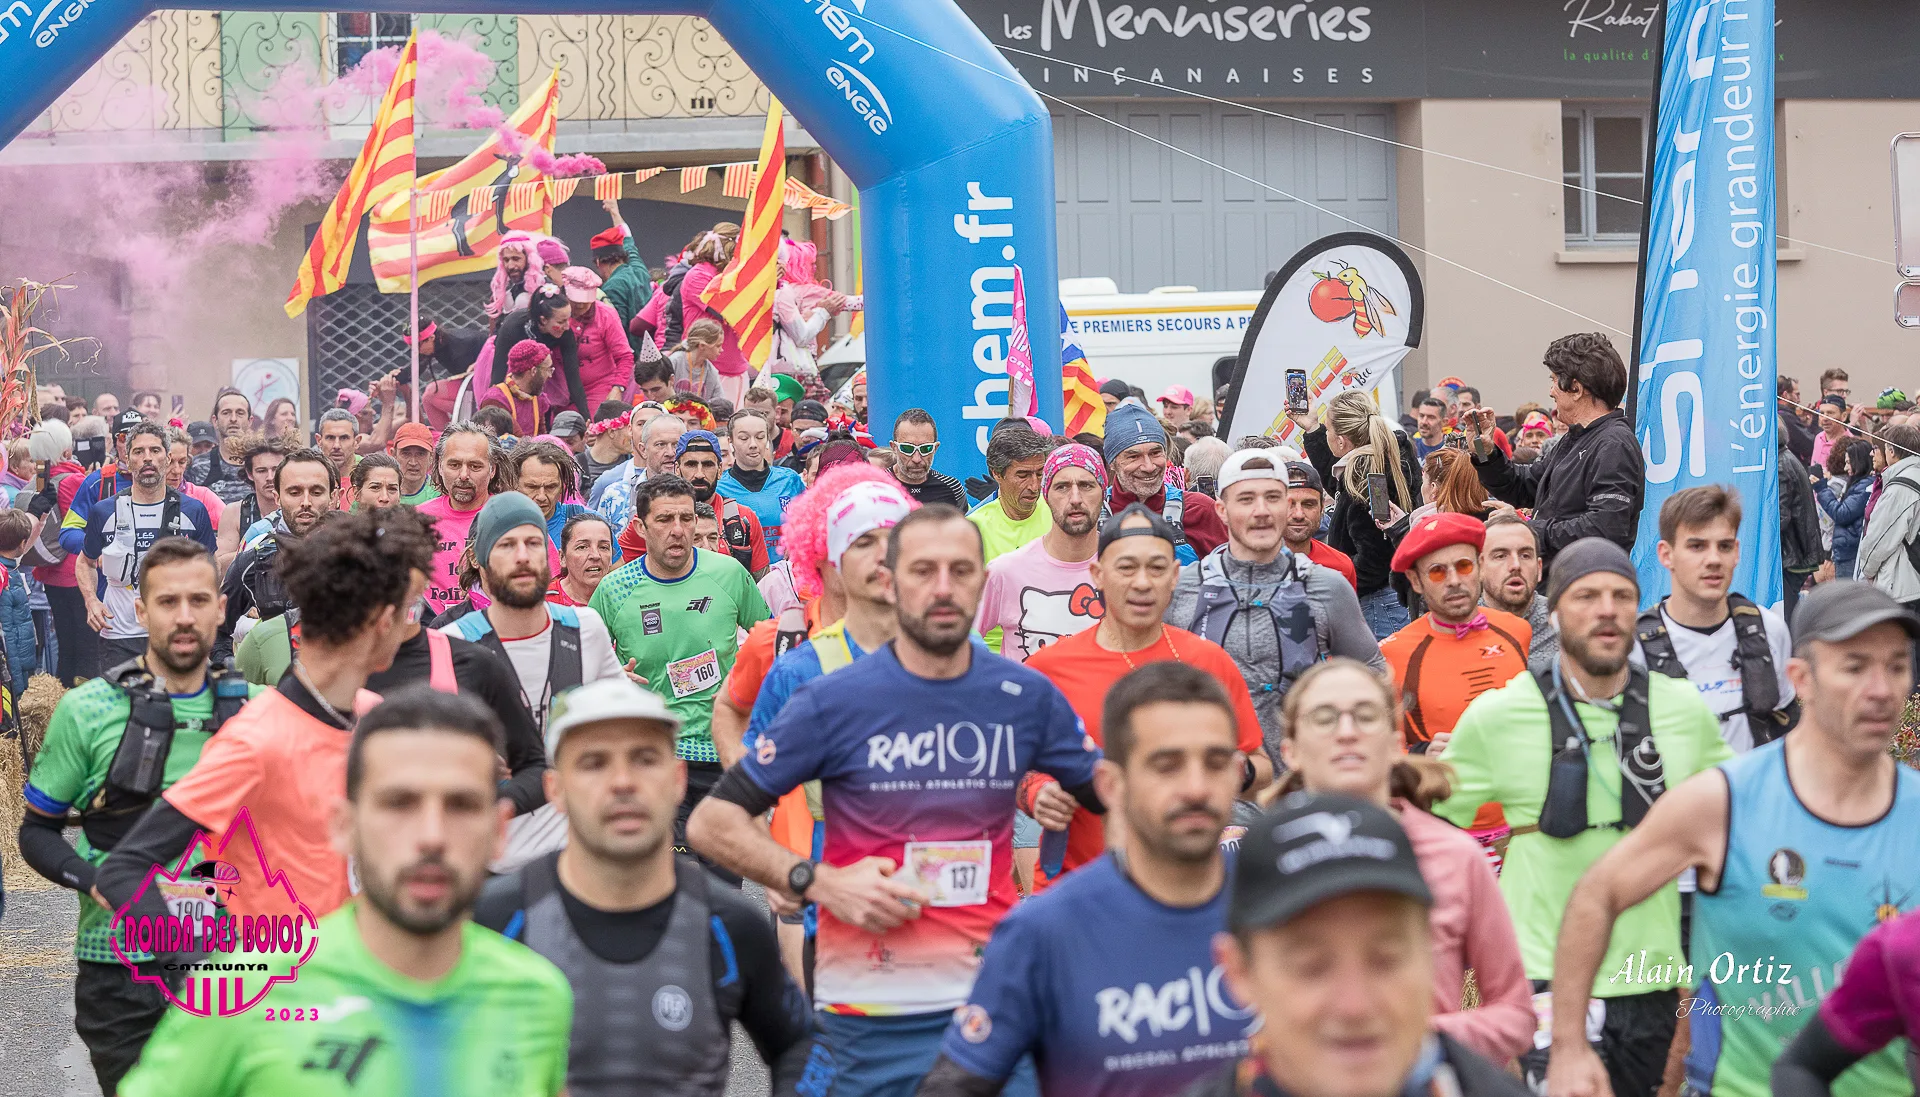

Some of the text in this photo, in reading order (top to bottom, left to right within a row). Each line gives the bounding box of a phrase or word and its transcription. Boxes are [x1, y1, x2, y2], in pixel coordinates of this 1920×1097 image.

[1003, 0, 1372, 51] les Menuiseries
[1563, 48, 1576, 61] la
[1583, 48, 1634, 62] qualité
[1015, 67, 1373, 86] INÇANAISES
[1713, 0, 1767, 473] L'énergie grandeur n
[1083, 319, 1152, 333] PREMIERS
[1157, 316, 1221, 331] SECOURS
[1226, 316, 1234, 329] A
[695, 663, 714, 682] 160
[951, 865, 977, 889] 137
